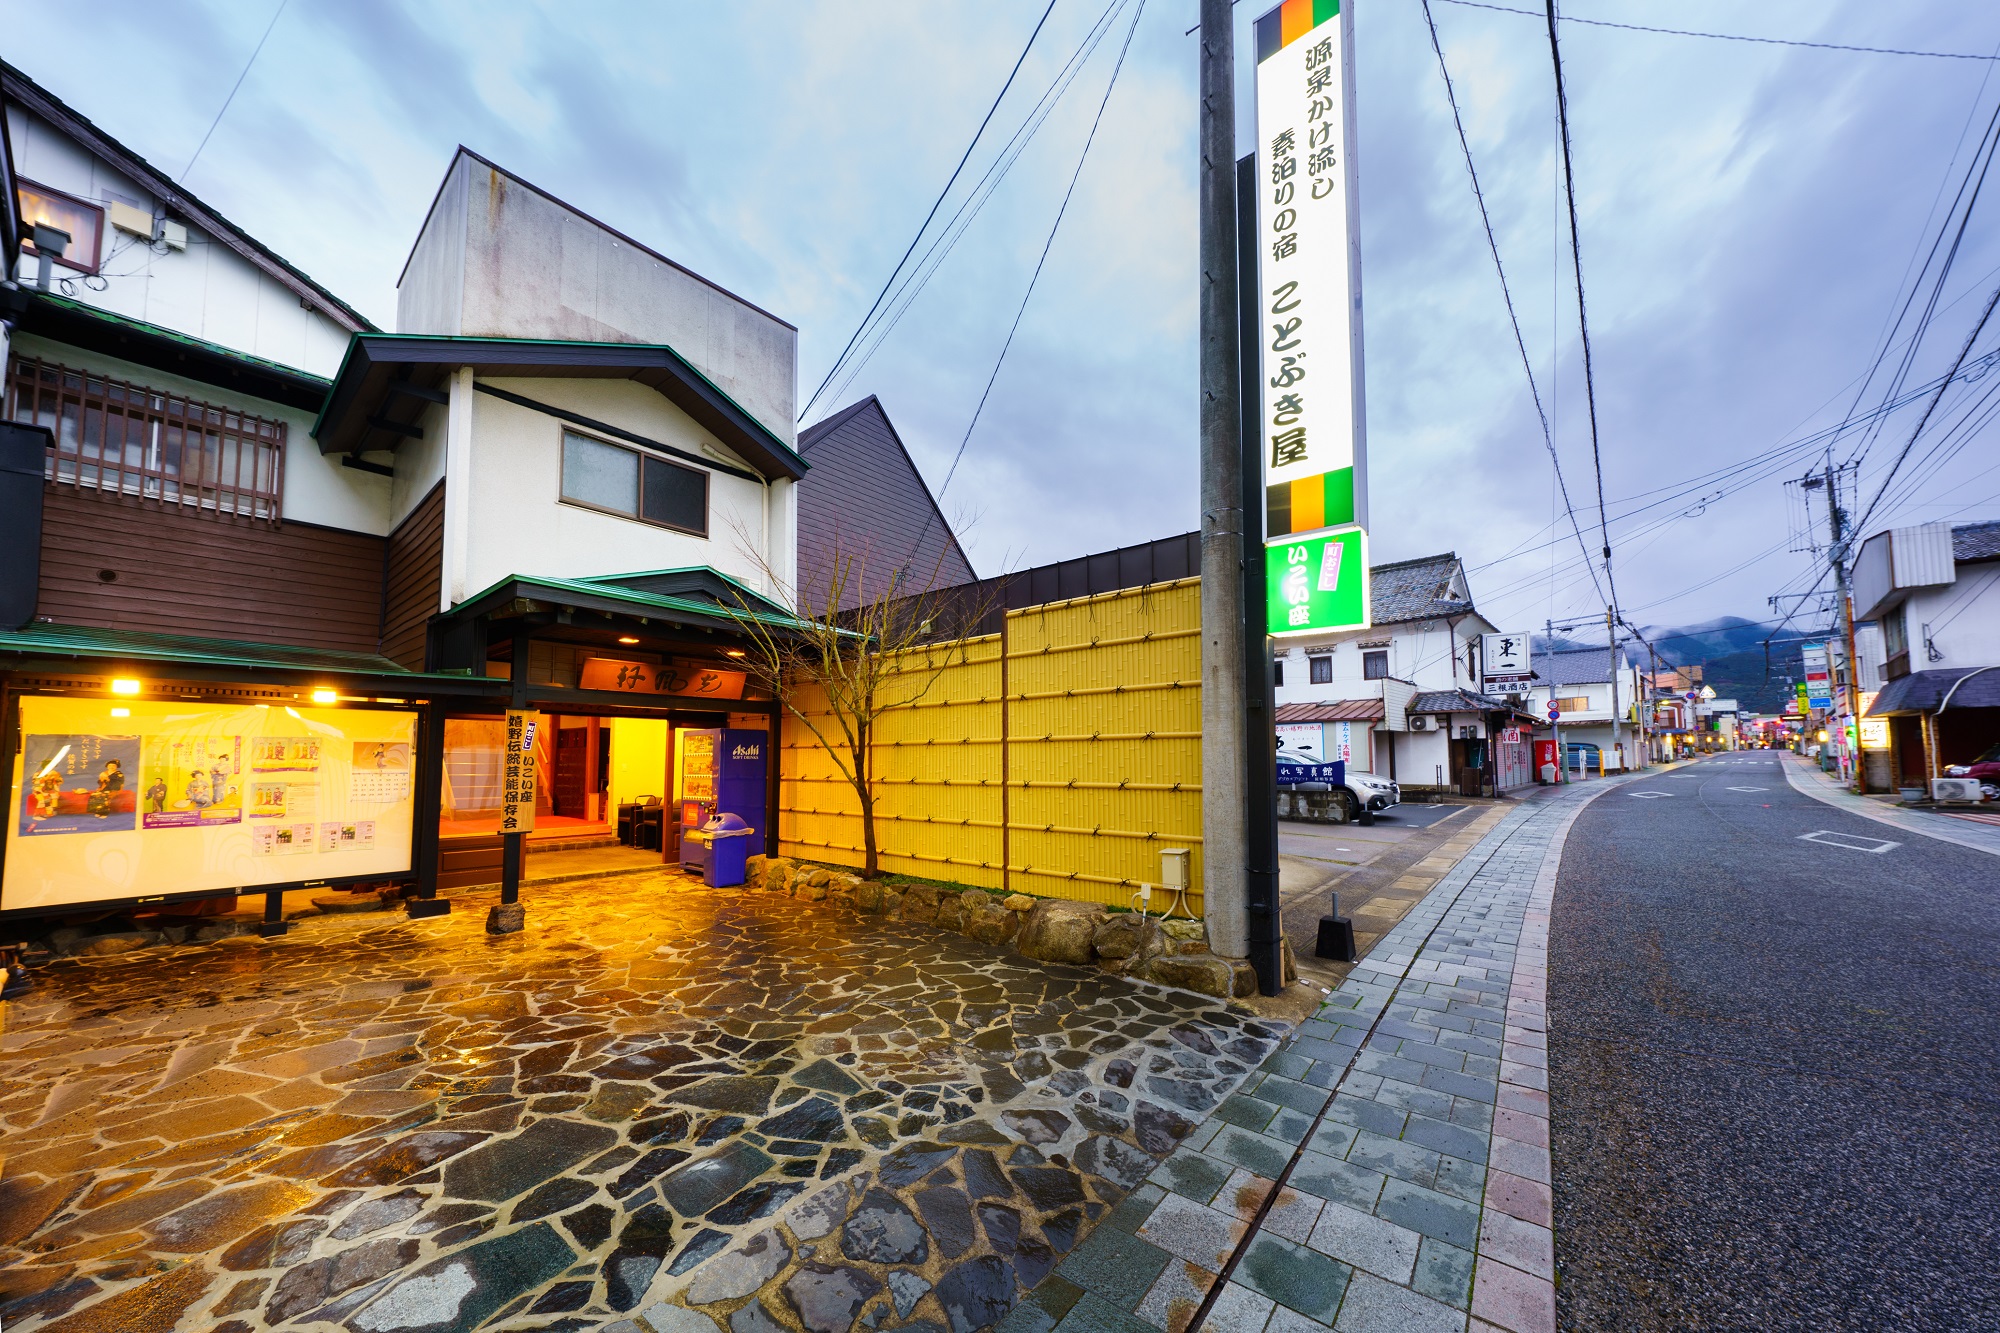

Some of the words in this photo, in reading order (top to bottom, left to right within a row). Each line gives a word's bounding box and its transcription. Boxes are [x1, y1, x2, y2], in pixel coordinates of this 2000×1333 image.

[1305, 36, 1336, 200] 源泉かけ流し
[1271, 127, 1298, 262] 素泊りの宿
[1270, 280, 1309, 469] ことぶき屋
[1287, 545, 1311, 627] いこい座
[1324, 546, 1339, 588] 町おこし
[1488, 682, 1528, 692] 三根酒店
[732, 744, 760, 756] Asahi
[1503, 730, 1519, 743] 酒
[503, 715, 523, 829] 嬉野伝統芸能保存会
[520, 756, 535, 803] いこい座
